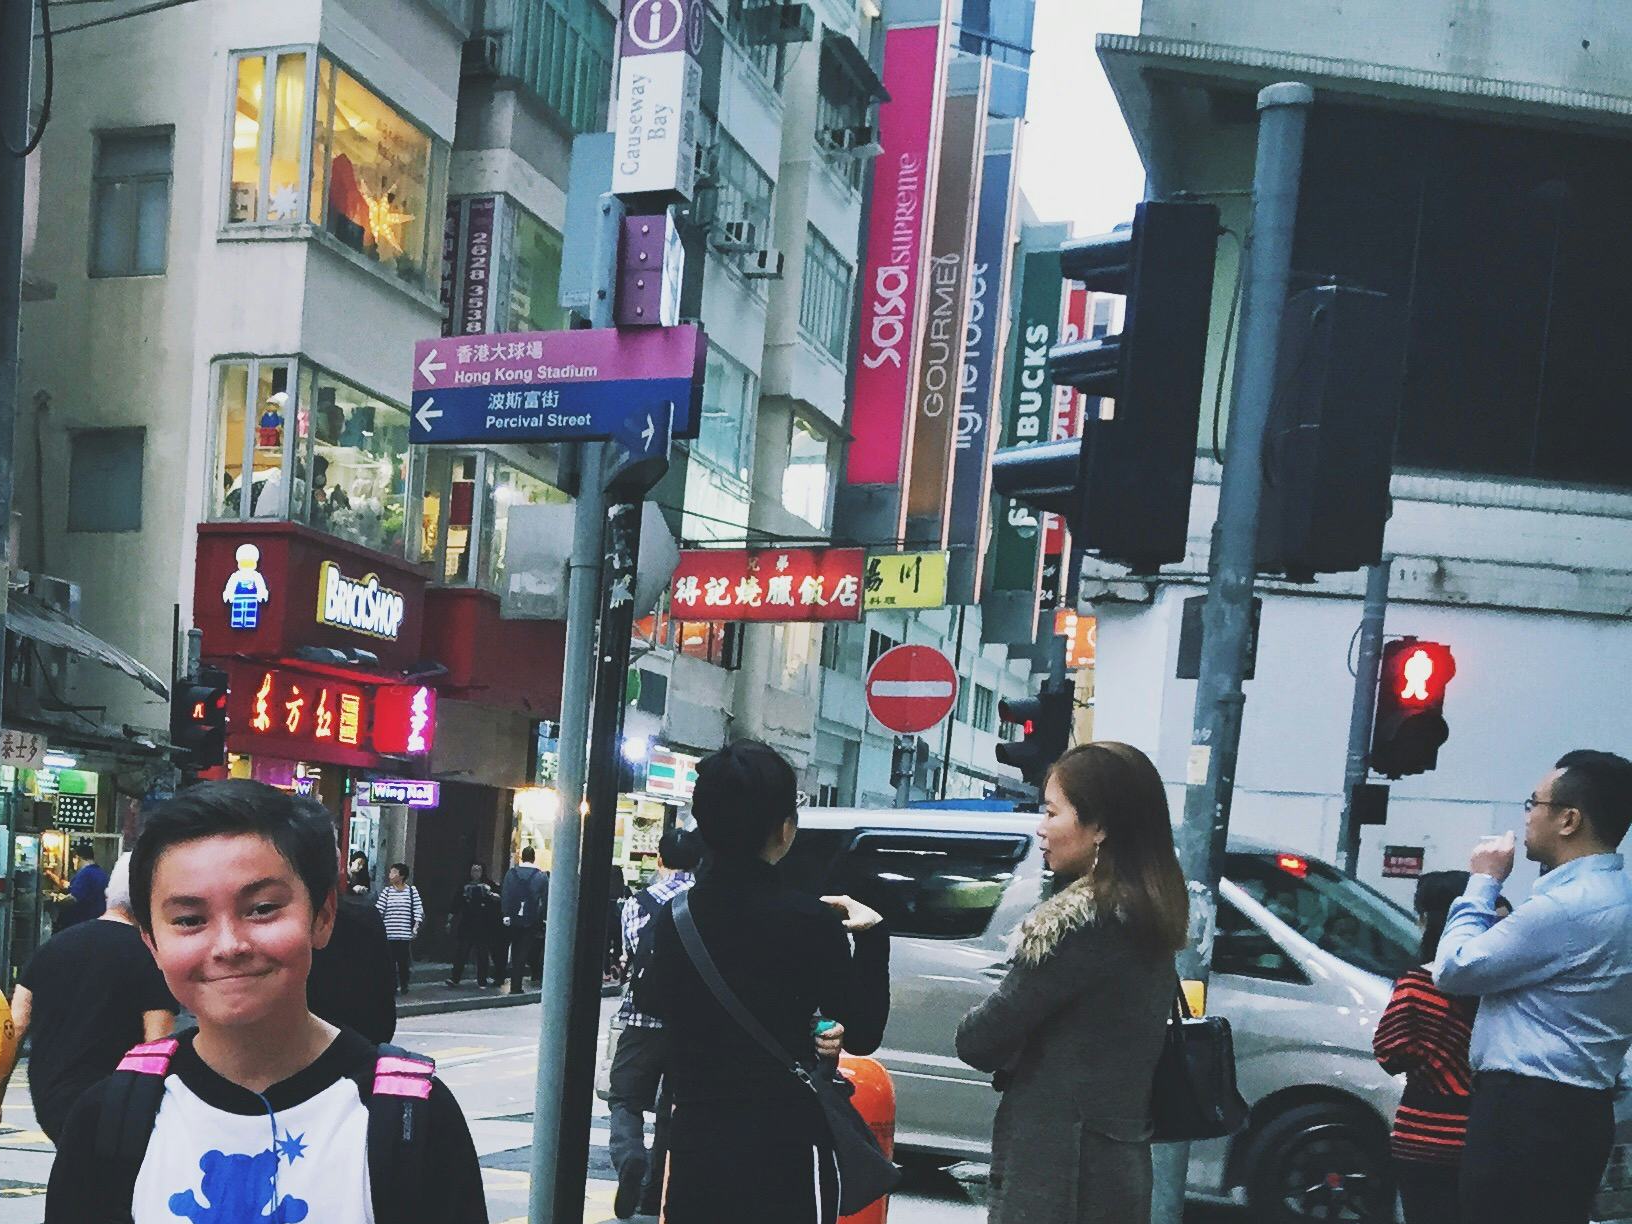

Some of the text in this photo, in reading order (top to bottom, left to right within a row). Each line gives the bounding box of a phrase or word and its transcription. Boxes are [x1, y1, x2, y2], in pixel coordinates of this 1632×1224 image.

[620, 74, 652, 176] Causeway
[647, 104, 674, 142] Bay
[457, 341, 543, 364] 香港大球場
[454, 364, 598, 385] Hong Kong Stadium
[487, 390, 560, 411] 波斯富街
[485, 413, 591, 429] Percival Street
